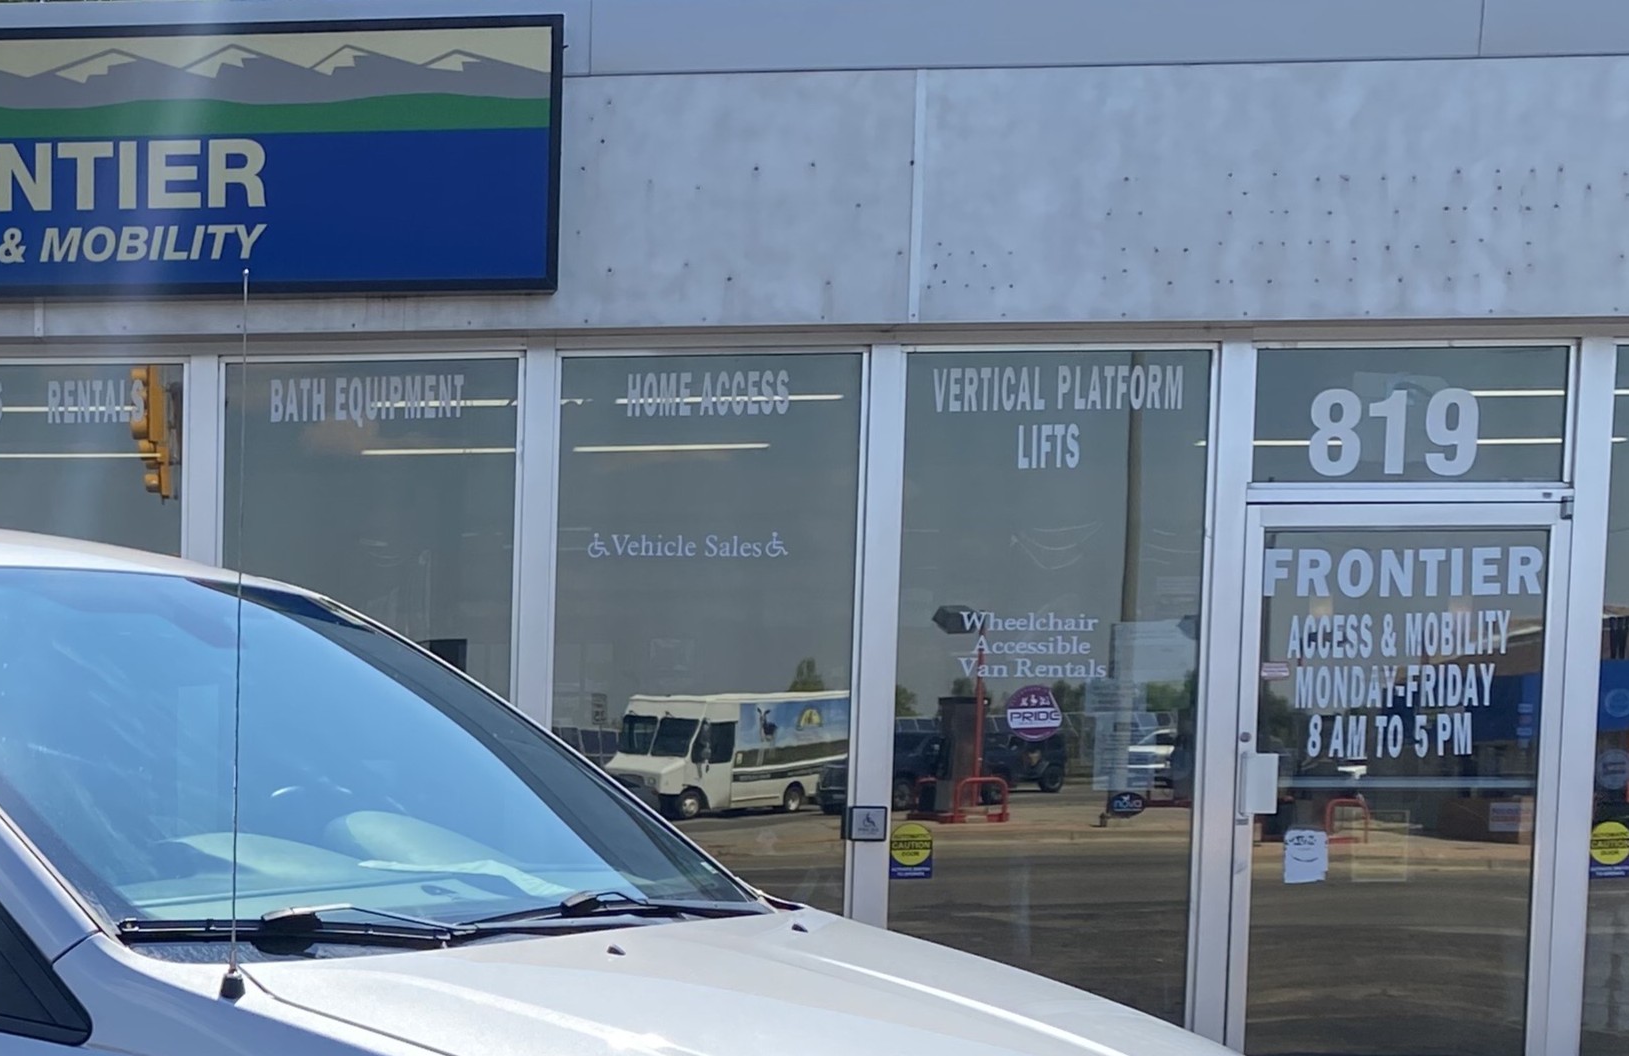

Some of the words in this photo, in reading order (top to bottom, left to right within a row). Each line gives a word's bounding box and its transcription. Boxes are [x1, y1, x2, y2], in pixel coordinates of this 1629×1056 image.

[39, 224, 267, 262] MOBILITY
[47, 379, 145, 424] RENTALS
[270, 378, 326, 422] BATH
[335, 375, 464, 427] EQUIPMENT
[627, 372, 692, 417] HOME
[699, 370, 789, 416] ACCESS
[933, 366, 1045, 412] VERTICAL
[1057, 365, 1184, 410] PLATFORM
[1017, 423, 1080, 470] LIFTS
[1308, 387, 1479, 477] 819
[611, 533, 697, 557] Vehicle
[704, 534, 763, 558] Sales
[1263, 546, 1544, 598] FRONTIER
[960, 611, 1099, 632] Wheelchair
[1287, 613, 1373, 659] ACCESS
[1381, 613, 1397, 658] &
[1405, 610, 1511, 657] MOBILITY
[958, 656, 1009, 678] Van
[1013, 657, 1107, 679] Rentals
[971, 635, 1091, 655] Accessible
[1294, 662, 1495, 710] MONDAY-FRIDAY
[1010, 710, 1061, 722] PRIDE
[1307, 714, 1321, 758] 8
[1328, 714, 1368, 758] AM
[1375, 714, 1404, 758] TO
[1414, 713, 1429, 758] 5
[1437, 712, 1473, 757] PM
[891, 840, 931, 849] CAUTION
